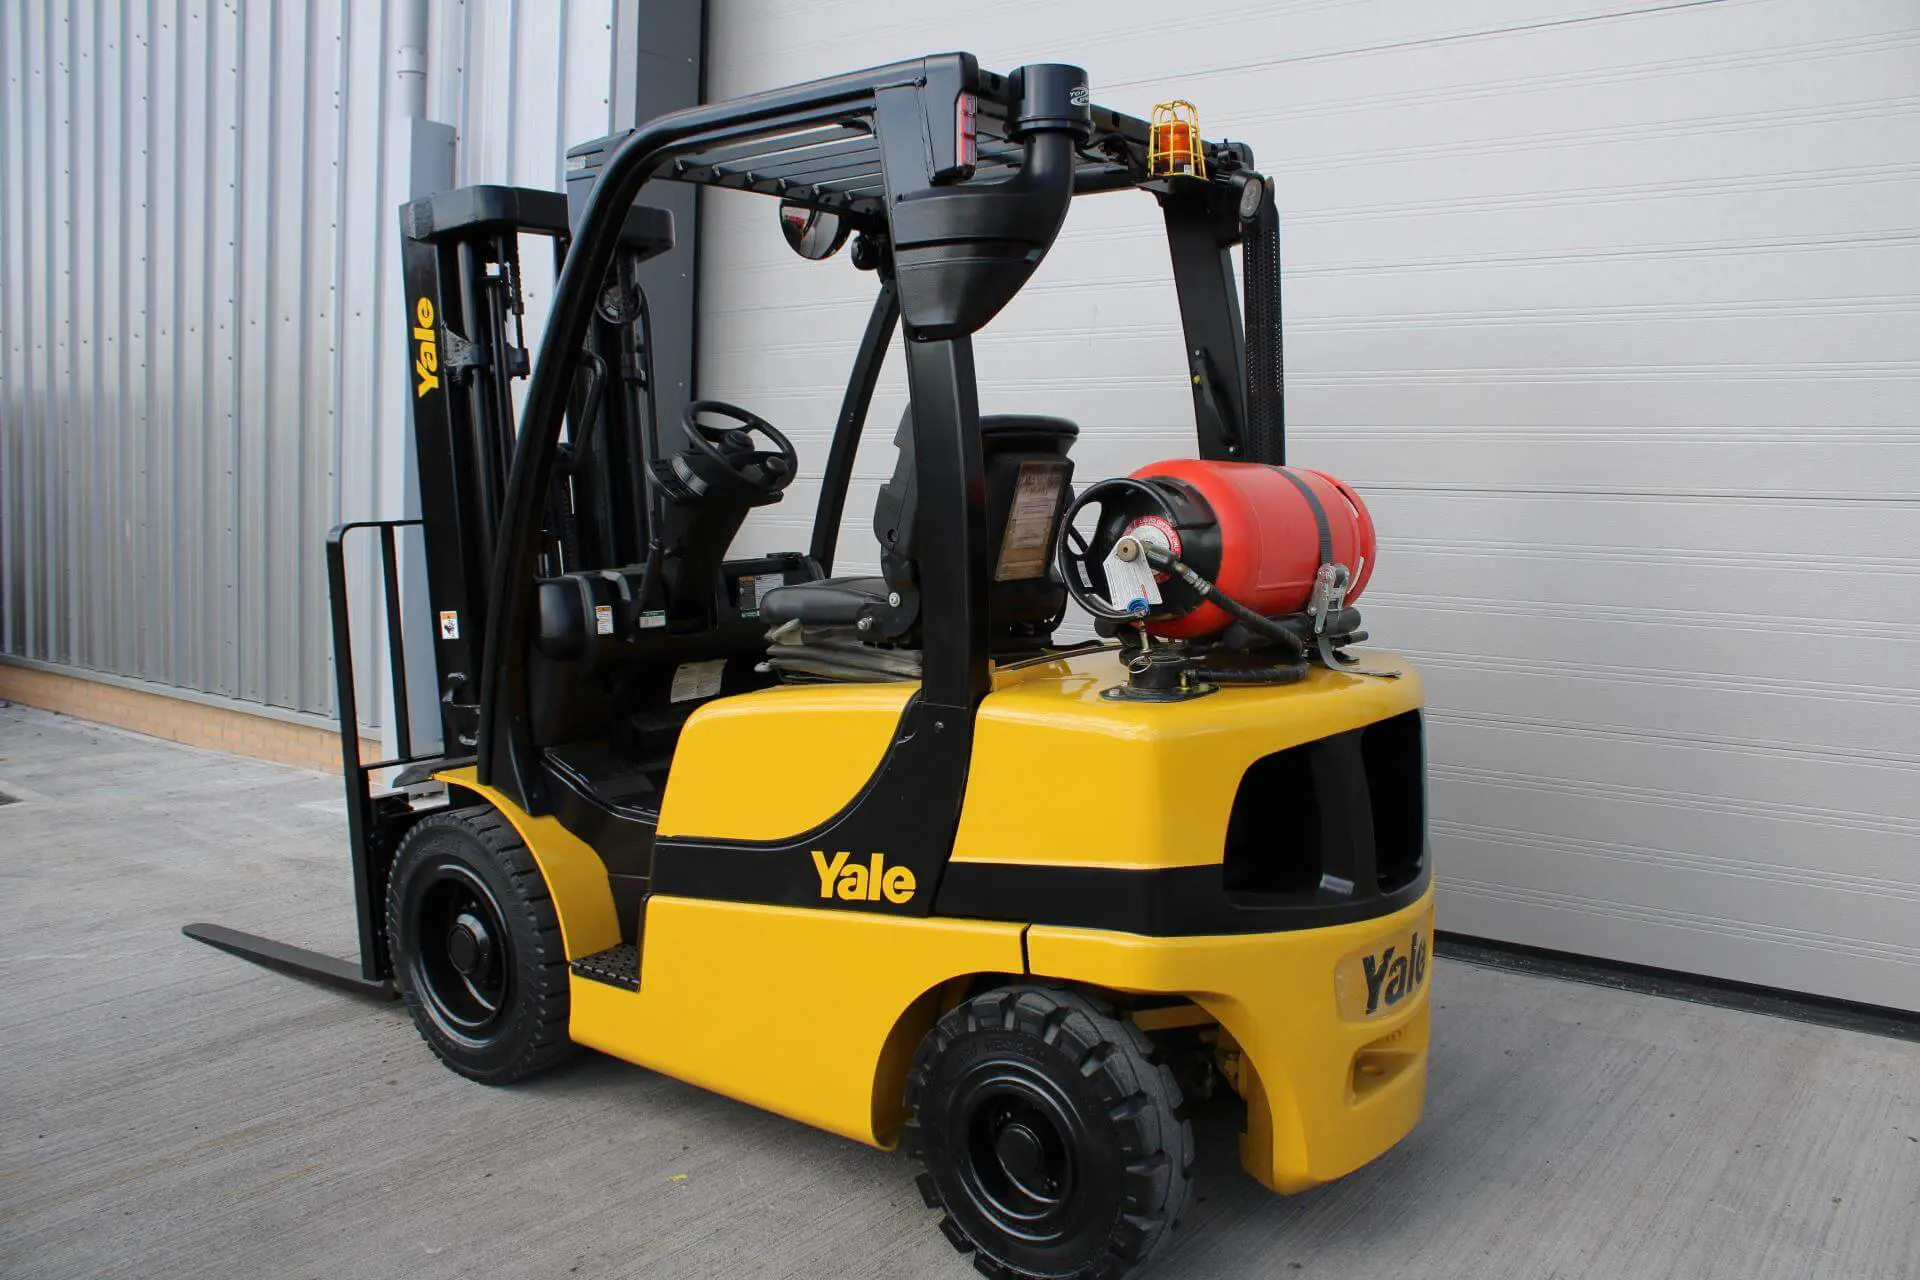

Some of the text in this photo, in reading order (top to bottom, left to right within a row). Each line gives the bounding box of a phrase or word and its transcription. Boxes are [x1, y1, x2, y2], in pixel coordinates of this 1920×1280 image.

[414, 297, 439, 398] Yale
[811, 851, 917, 904] Yale
[1362, 931, 1426, 1015] Yale
